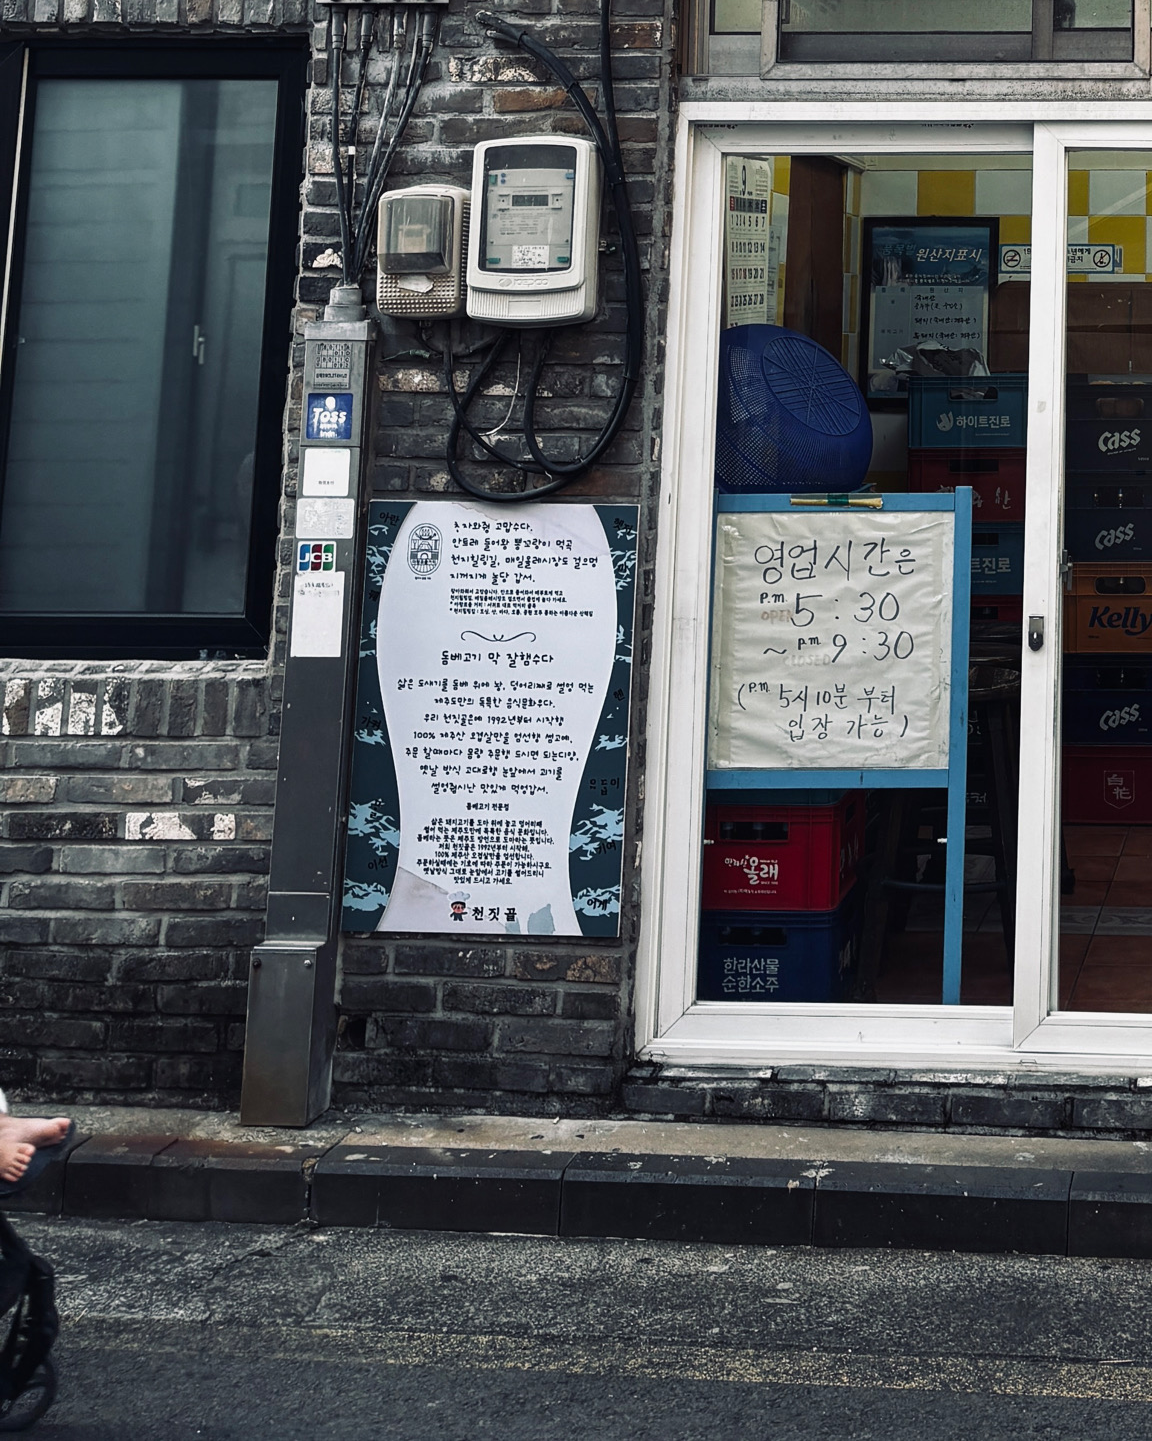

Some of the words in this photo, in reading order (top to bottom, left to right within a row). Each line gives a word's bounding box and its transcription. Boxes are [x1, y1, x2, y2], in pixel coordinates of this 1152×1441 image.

[916, 248, 983, 262] 원산지표시
[1067, 248, 1091, 257] 년에게
[956, 415, 1011, 429] 하이트진로
[299, 552, 333, 562] JCB
[754, 537, 917, 584] 영업시간은
[857, 685, 896, 715] 부터
[743, 856, 778, 885] 올래
[472, 907, 517, 921] 천짓골
[723, 957, 780, 975] 한라산물
[721, 975, 780, 993] 순한소주
